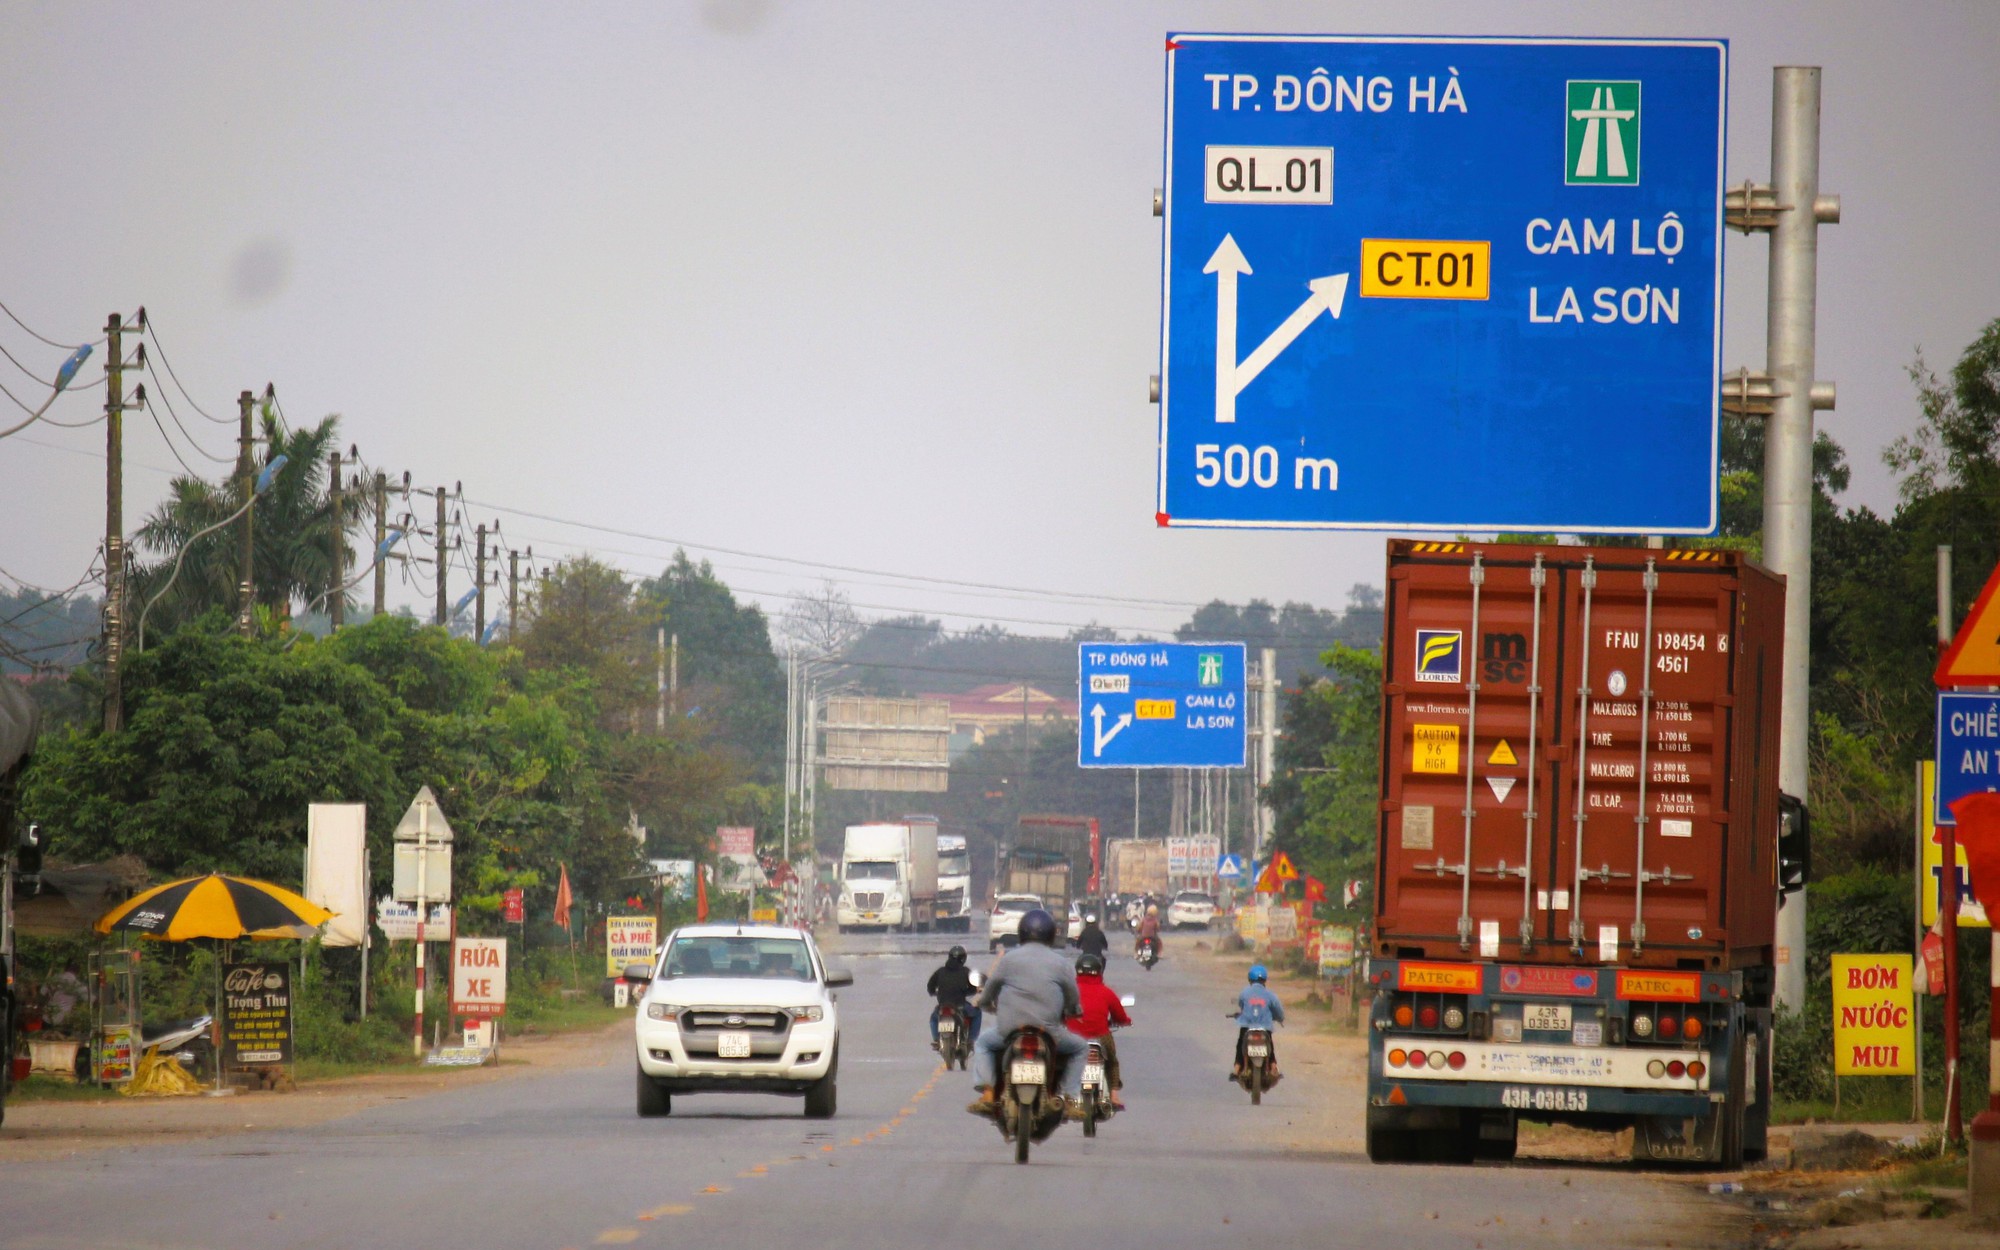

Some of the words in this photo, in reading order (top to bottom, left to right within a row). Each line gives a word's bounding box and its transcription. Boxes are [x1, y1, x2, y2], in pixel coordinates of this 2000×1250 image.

[1204, 74, 1260, 112] TP.
[1273, 67, 1393, 113] ĐÔNG
[1408, 67, 1468, 113] HÀ
[1216, 157, 1323, 194] QL.01
[1525, 217, 1615, 256] CAM
[1632, 212, 1684, 264] LỘ
[1376, 251, 1475, 288] CT.01
[1530, 287, 1584, 324] LA
[1592, 284, 1680, 325] SƠN
[1195, 444, 1279, 489] 500
[1294, 456, 1339, 491] m
[1605, 631, 1639, 649] FFAU
[1657, 632, 1705, 651] 198454
[1718, 635, 1727, 651] 6
[1089, 653, 1106, 666] TP.
[1151, 650, 1168, 666] HÀ
[1656, 656, 1689, 673] 45G1
[1417, 673, 1460, 681] FLORENS
[1186, 695, 1215, 708] CAM
[1218, 692, 1235, 711] LỘ
[1593, 702, 1637, 716] MAX.GROSS
[1186, 716, 1205, 729] LA
[1208, 716, 1235, 729] SƠN
[1679, 712, 1692, 721] LBS
[1951, 702, 2000, 738] CHIỀ
[1417, 729, 1456, 741] CAUTION
[1592, 733, 1612, 747] TARE
[1425, 758, 1446, 769] HIGH
[1590, 762, 1635, 778] MAX.CARGO
[1960, 749, 1989, 774] AN
[1677, 774, 1690, 783] LBS
[611, 929, 626, 943] CÀ
[630, 929, 652, 943] PHÊ
[460, 942, 500, 968] RỬA
[224, 967, 265, 996] Café
[1408, 970, 1454, 985] PATEC
[1846, 963, 1900, 990] BƠM
[466, 978, 491, 998] XE
[1625, 979, 1672, 993] PATEC
[227, 995, 262, 1011] Trọng
[264, 994, 287, 1007] Thu
[1538, 1007, 1558, 1018] 43R
[1840, 1000, 1908, 1029] NƯỚC
[1528, 1018, 1567, 1030] 038.53
[1851, 1046, 1900, 1068] MUI
[1501, 1087, 1588, 1112] 43R-038.53
